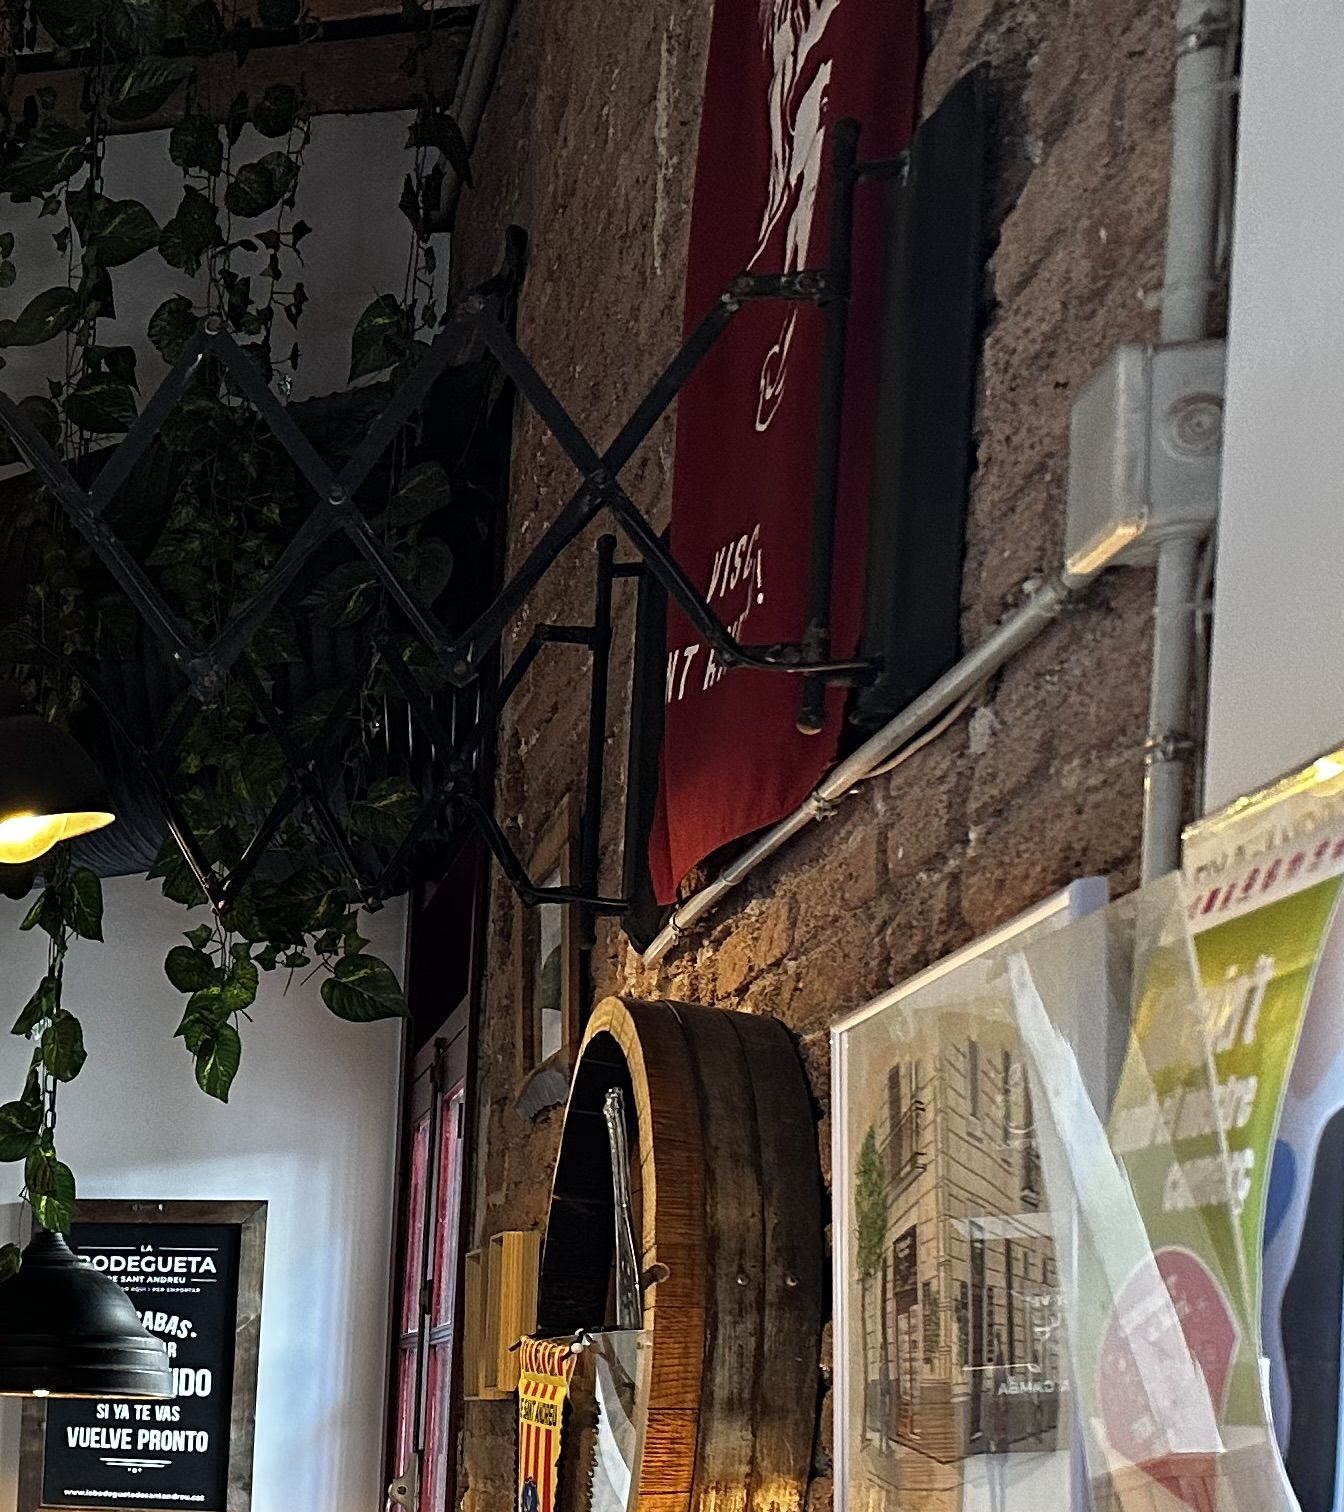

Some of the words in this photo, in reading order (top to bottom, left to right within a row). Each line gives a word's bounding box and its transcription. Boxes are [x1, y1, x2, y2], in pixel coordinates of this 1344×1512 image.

[120, 1275, 145, 1283] SANT
[146, 1276, 186, 1284] ANDREU
[96, 1403, 109, 1419] SI
[113, 1404, 130, 1420] YA
[134, 1404, 151, 1421] TE
[155, 1405, 180, 1422] VAS
[67, 1426, 133, 1450] VUELVE
[137, 1428, 209, 1452] PRONTO
